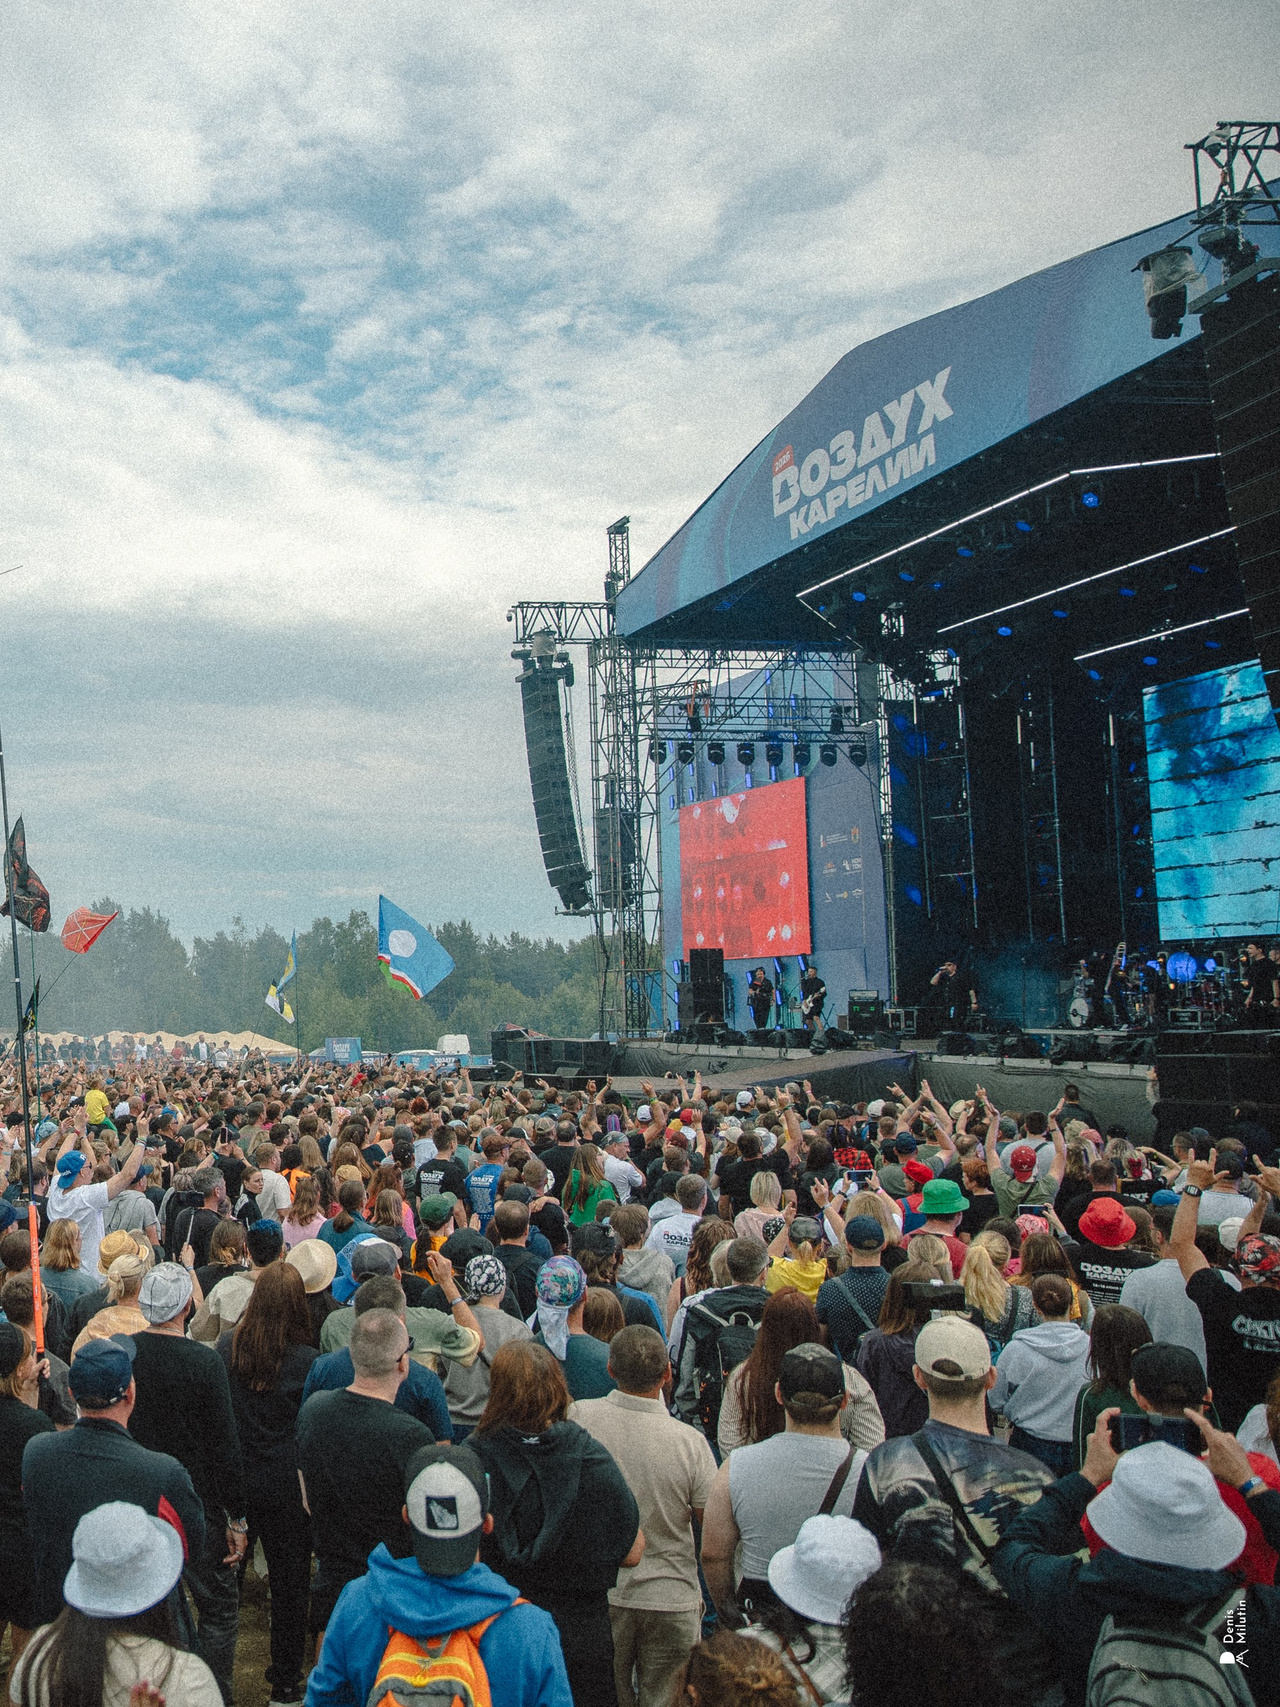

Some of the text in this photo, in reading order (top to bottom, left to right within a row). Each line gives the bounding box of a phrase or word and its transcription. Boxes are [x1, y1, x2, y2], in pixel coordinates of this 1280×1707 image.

[773, 366, 954, 518] ВОЗДУХ
[789, 433, 936, 540] КАРЕЛИИ
[663, 1233, 692, 1242] ВОЗД
[1080, 1262, 1133, 1276] ВОЗДУ
